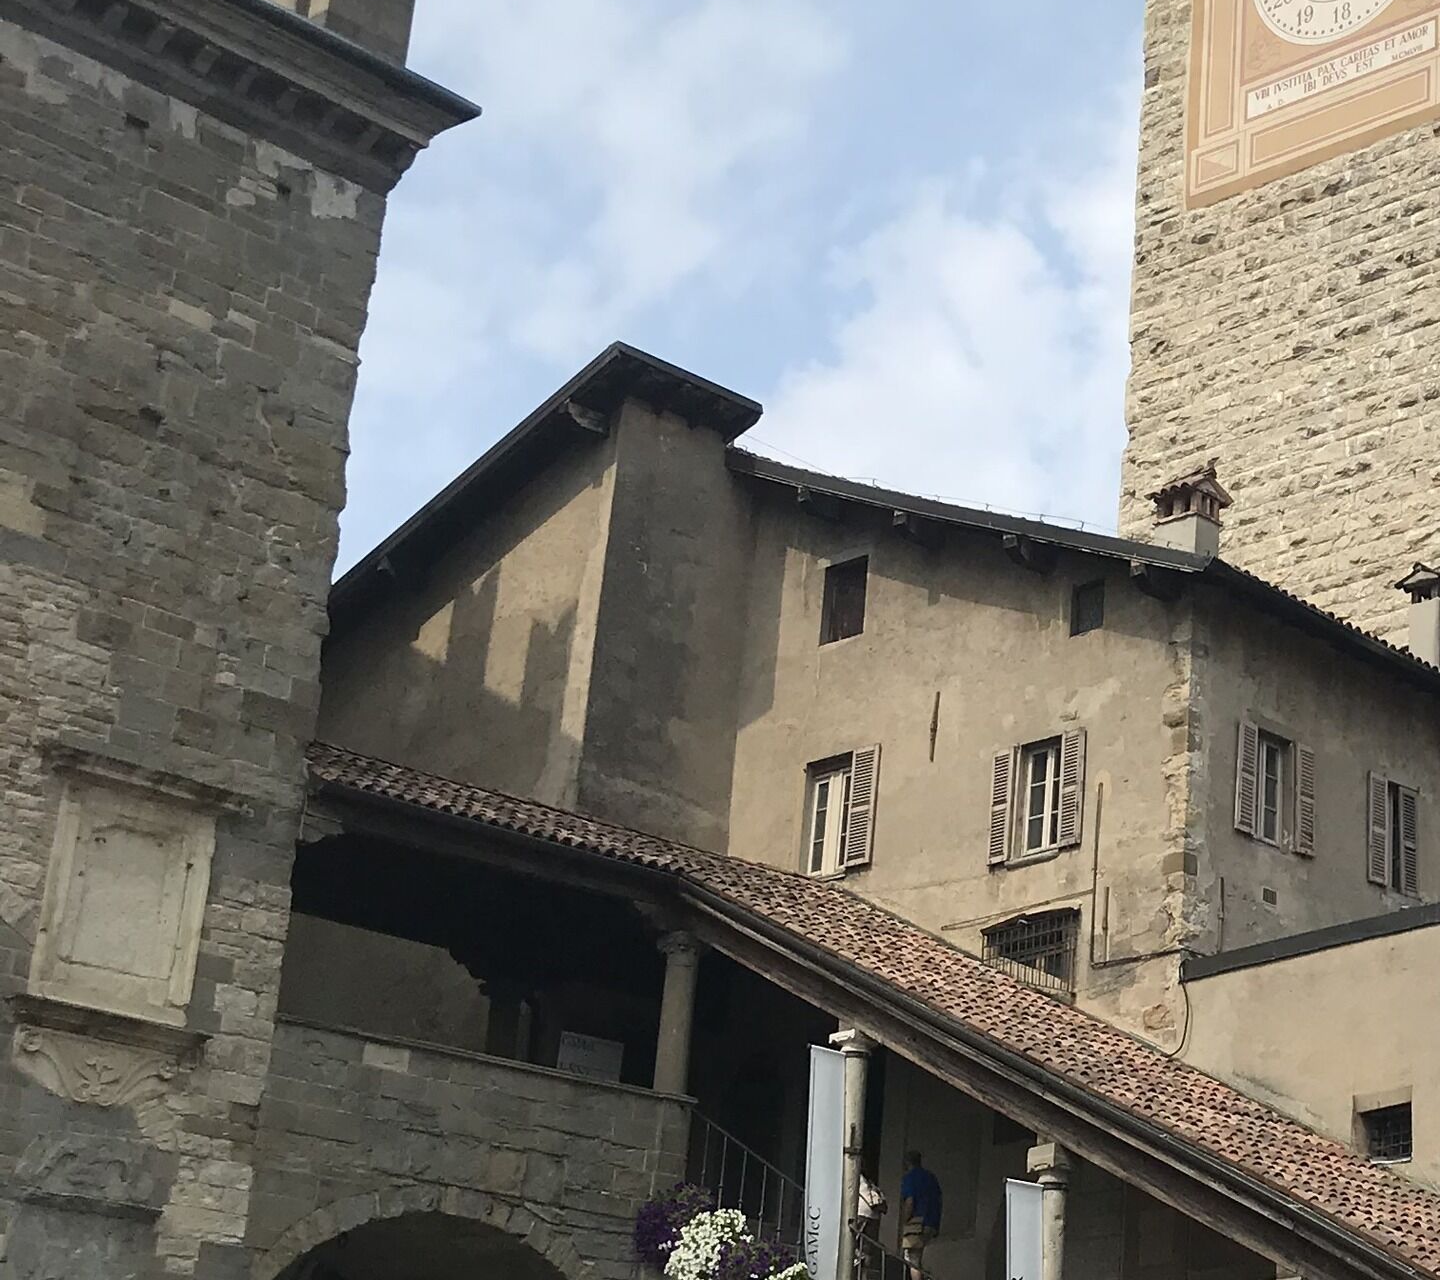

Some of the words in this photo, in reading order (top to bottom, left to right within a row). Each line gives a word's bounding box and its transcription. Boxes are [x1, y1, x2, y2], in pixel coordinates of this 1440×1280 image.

[1296, 5, 1314, 27] 19
[1333, 2, 1350, 23] 18
[1317, 62, 1336, 77] PAX
[1340, 45, 1380, 66] CARITAS
[1384, 38, 1396, 51] ET
[1400, 25, 1429, 45] AMOR
[1322, 69, 1347, 86] DEVS
[1355, 58, 1375, 73] EST
